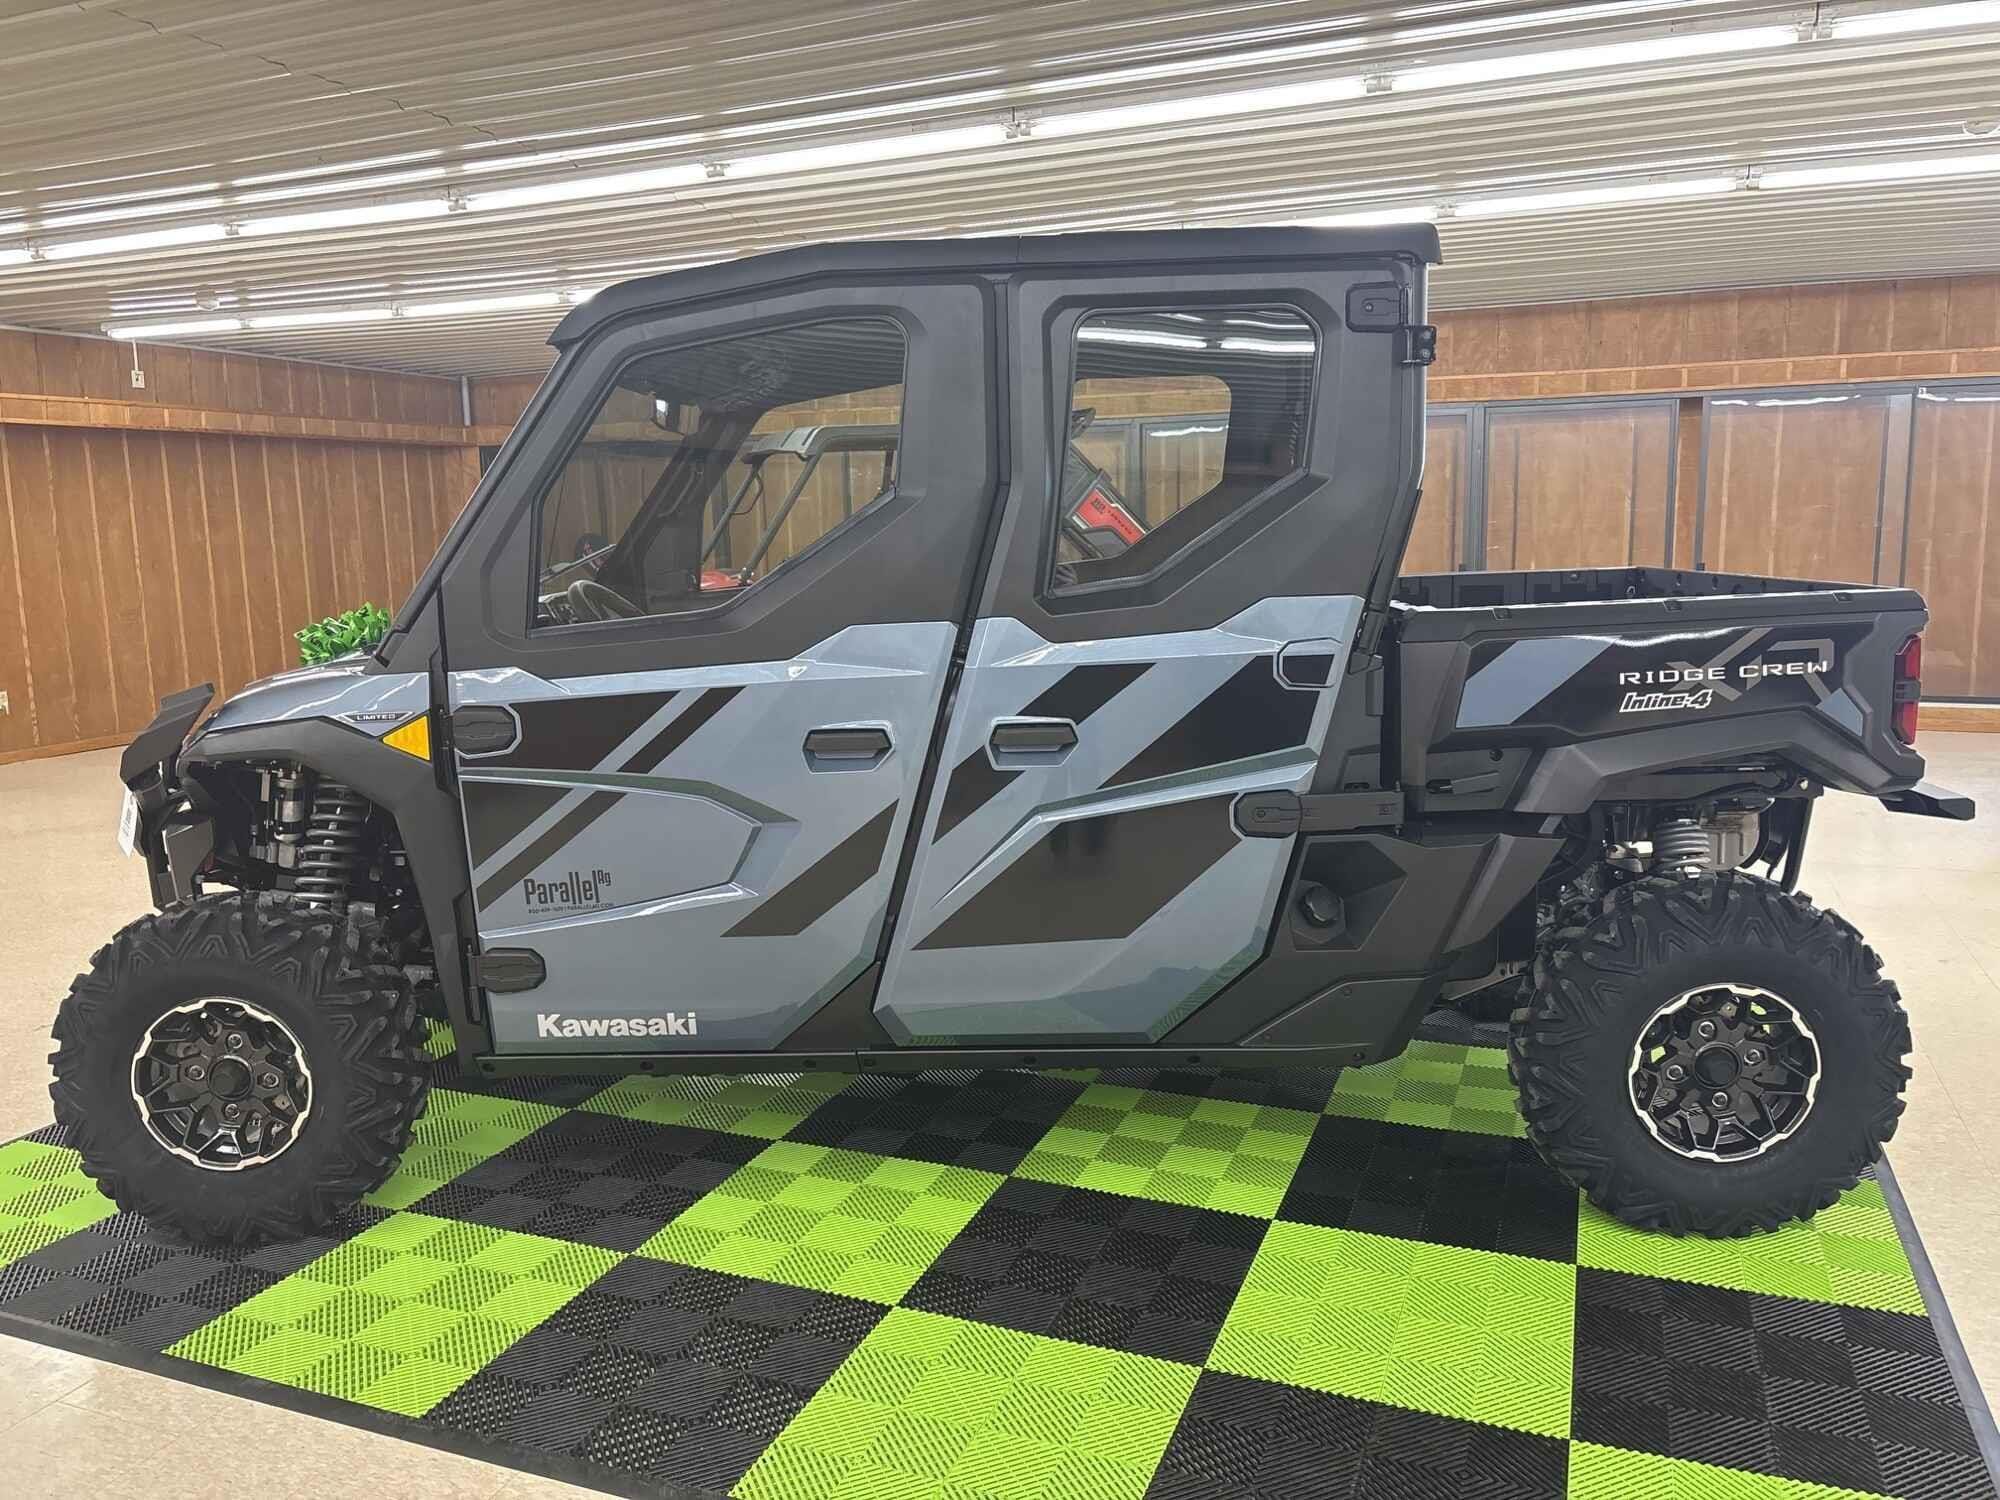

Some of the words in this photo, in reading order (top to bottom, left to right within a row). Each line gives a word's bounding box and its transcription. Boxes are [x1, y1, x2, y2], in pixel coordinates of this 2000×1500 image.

[1619, 666, 1726, 685] RIDGE
[1738, 660, 1828, 678] CREW
[1619, 689, 1713, 713] Inline-4
[356, 713, 396, 721] LIMITED
[537, 1012, 697, 1038] Kawasaki
